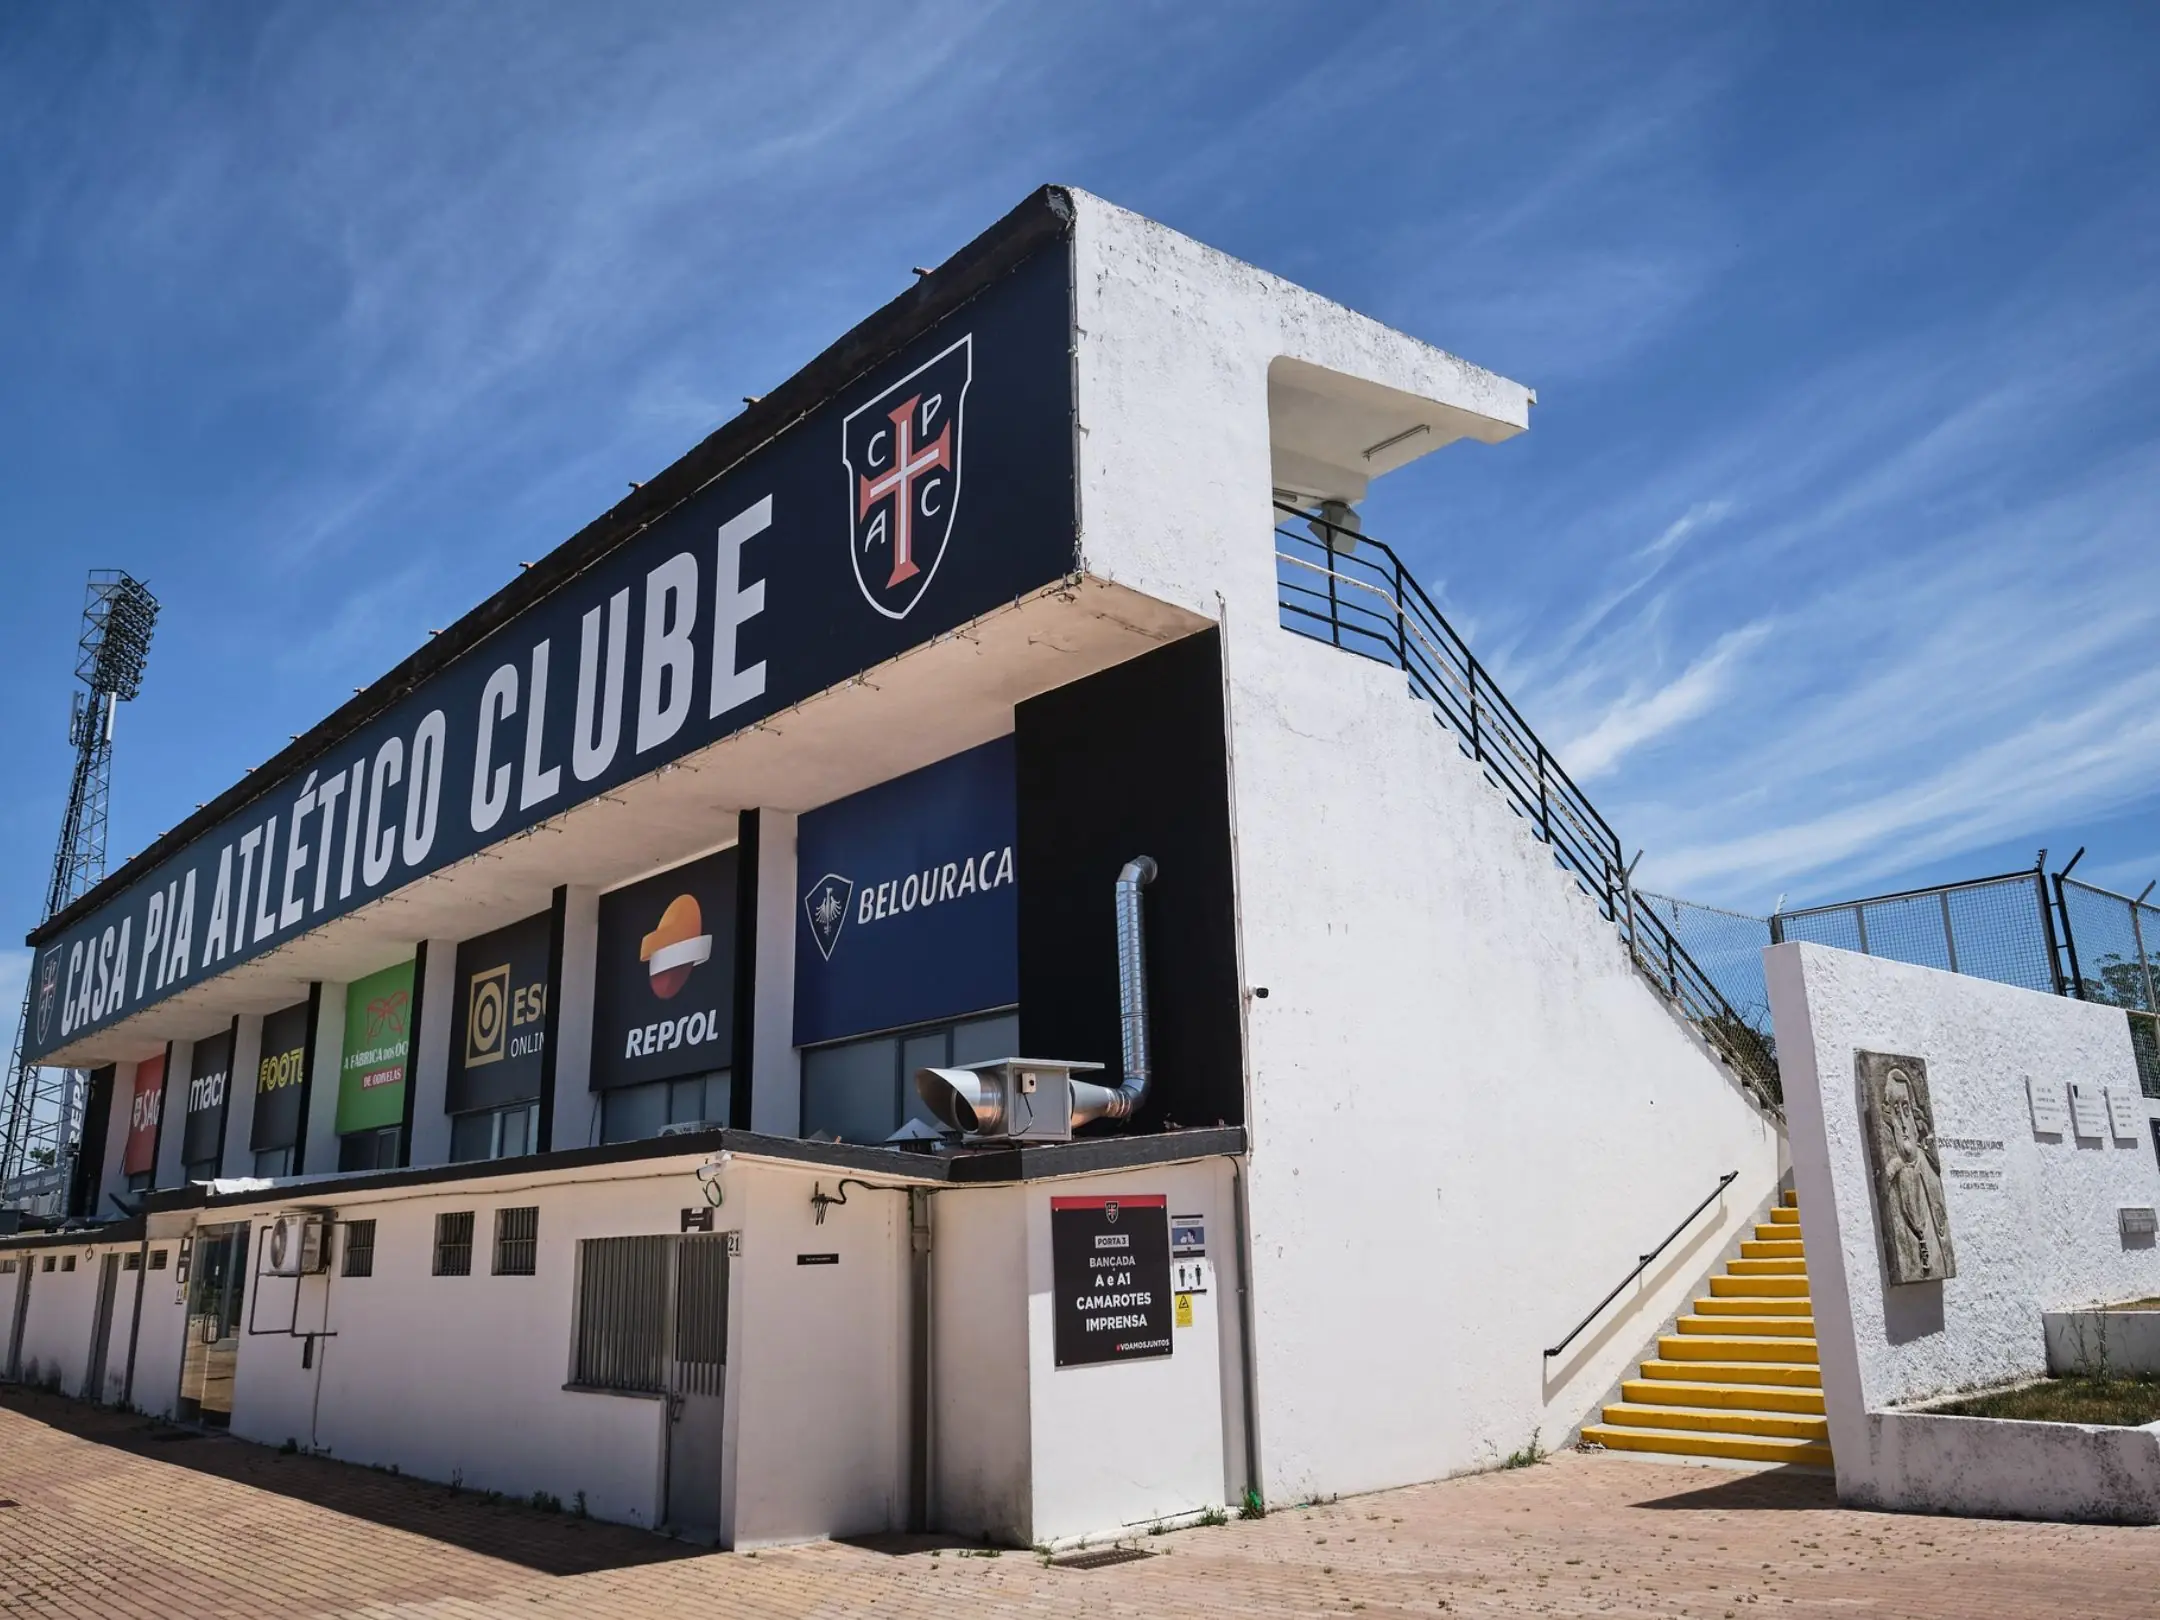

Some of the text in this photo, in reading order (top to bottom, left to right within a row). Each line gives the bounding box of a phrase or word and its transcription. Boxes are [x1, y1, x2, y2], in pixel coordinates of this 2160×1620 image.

[866, 393, 942, 467] C P
[864, 478, 941, 553] A C
[61, 493, 772, 1037] CASA PIA ATLÉTICO CLUBE
[857, 846, 1015, 925] BELOURACA
[625, 1010, 719, 1059] REPSOL
[728, 1236, 739, 1252] 21
[1097, 1236, 1127, 1246] PORTA 3
[1089, 1256, 1136, 1268] BANCADA
[1095, 1271, 1131, 1287] A e A1
[1076, 1292, 1151, 1310] CAMAROTES
[1086, 1313, 1147, 1332] IMPRENSA
